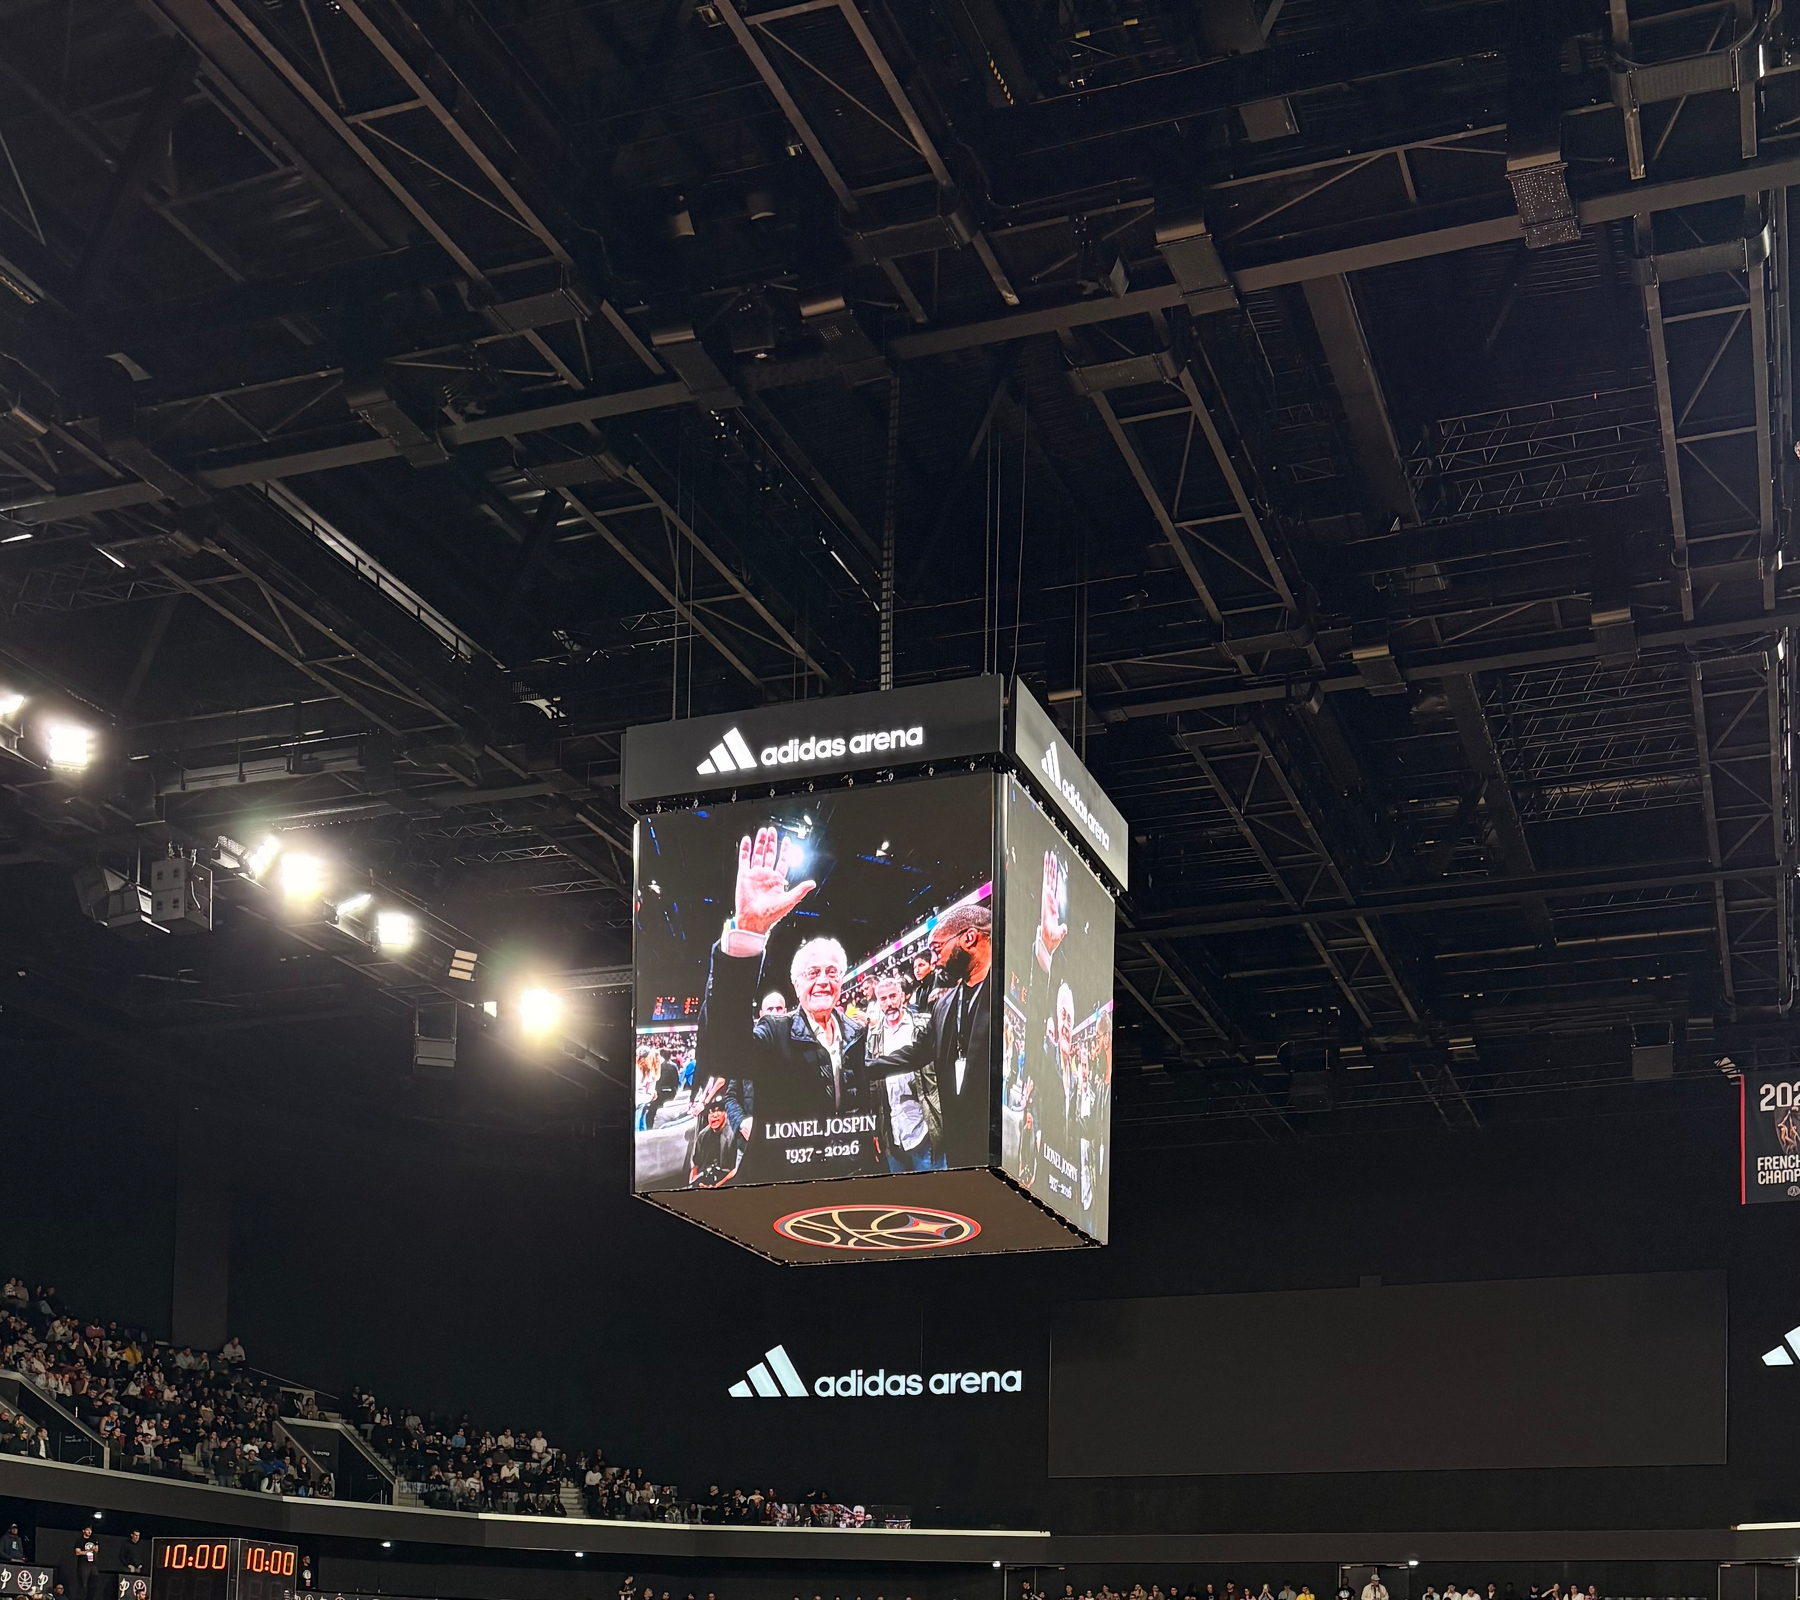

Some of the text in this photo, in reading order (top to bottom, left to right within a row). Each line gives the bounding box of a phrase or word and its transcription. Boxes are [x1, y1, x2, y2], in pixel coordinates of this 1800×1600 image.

[761, 727, 924, 766] adidas arena
[1062, 779, 1110, 851] adidas arena
[765, 1115, 877, 1139] LIONEL JOSPIN
[785, 1148, 814, 1164] 1937
[824, 1140, 860, 1157] 2026
[814, 1369, 1022, 1397] adidas arena
[164, 1544, 227, 1569] 10:00
[246, 1547, 295, 1576] 10:00
